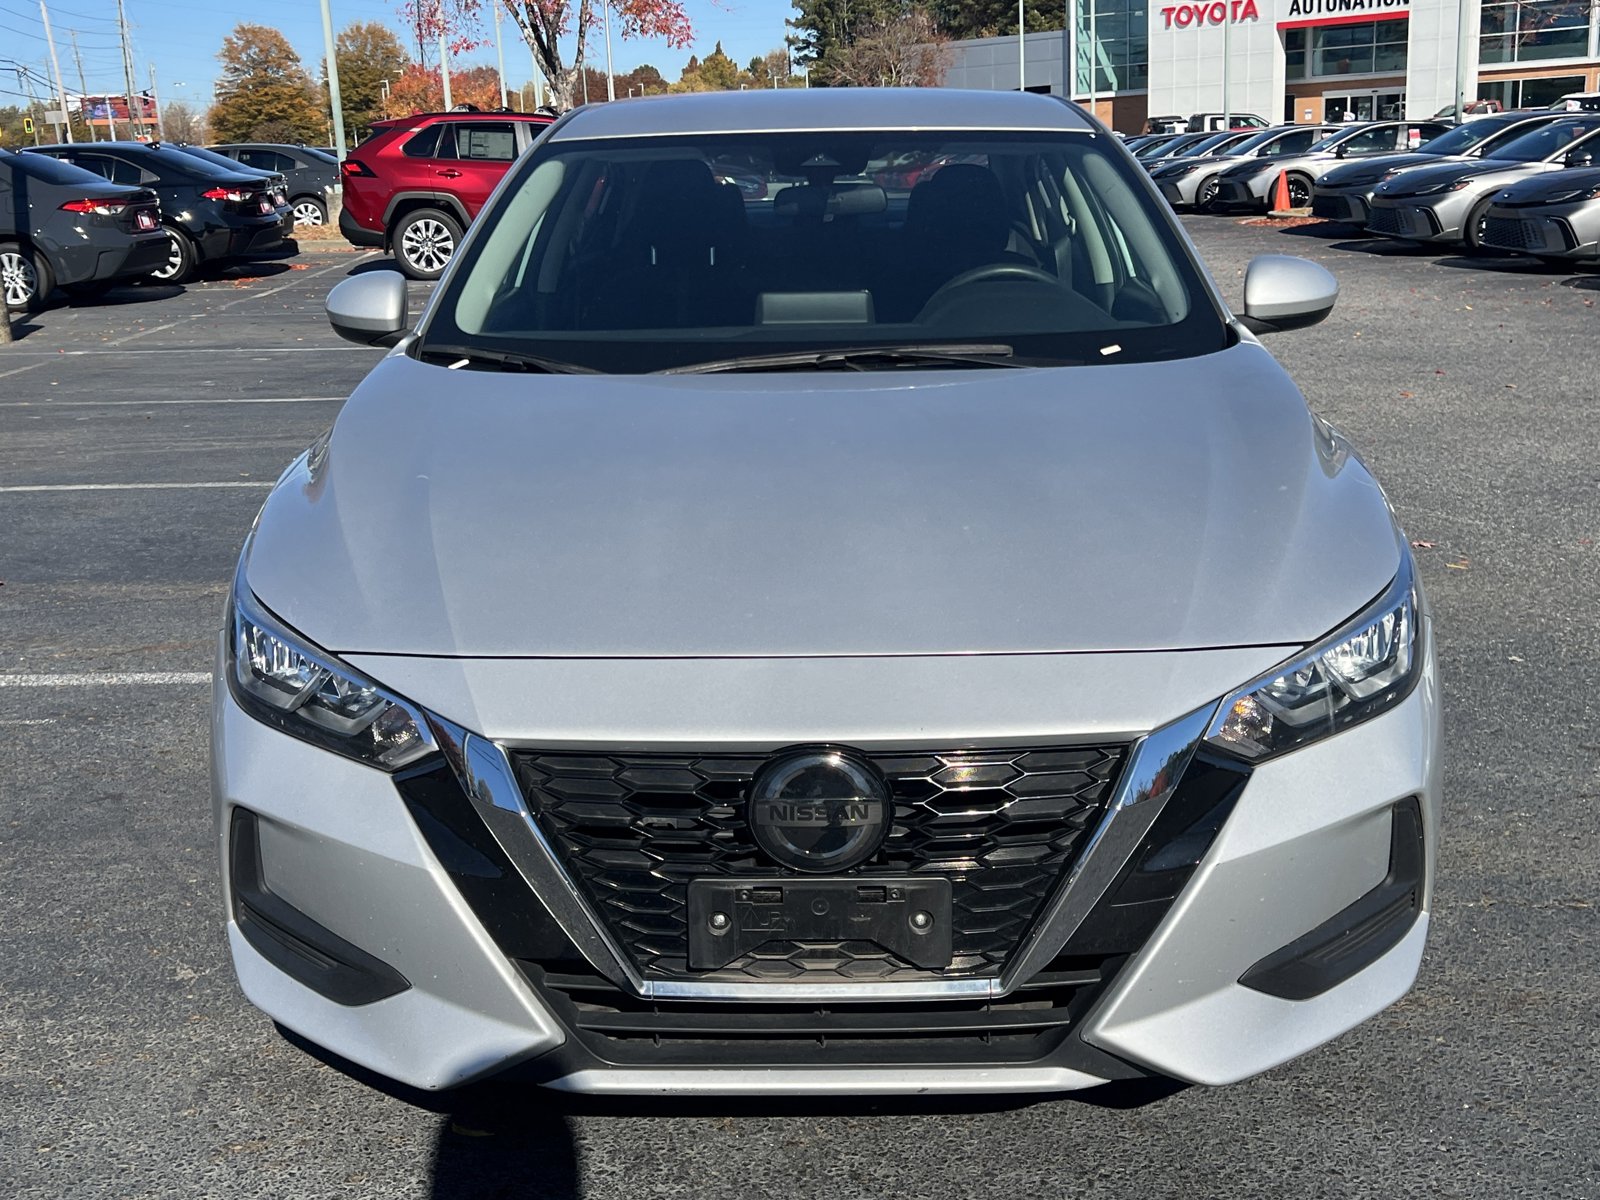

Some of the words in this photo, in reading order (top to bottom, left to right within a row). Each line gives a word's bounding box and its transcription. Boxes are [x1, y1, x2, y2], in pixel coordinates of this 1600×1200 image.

[1160, 0, 1258, 29] TOYOTA
[1289, 0, 1409, 16] AUTONA
[769, 804, 869, 821] NISSAN
